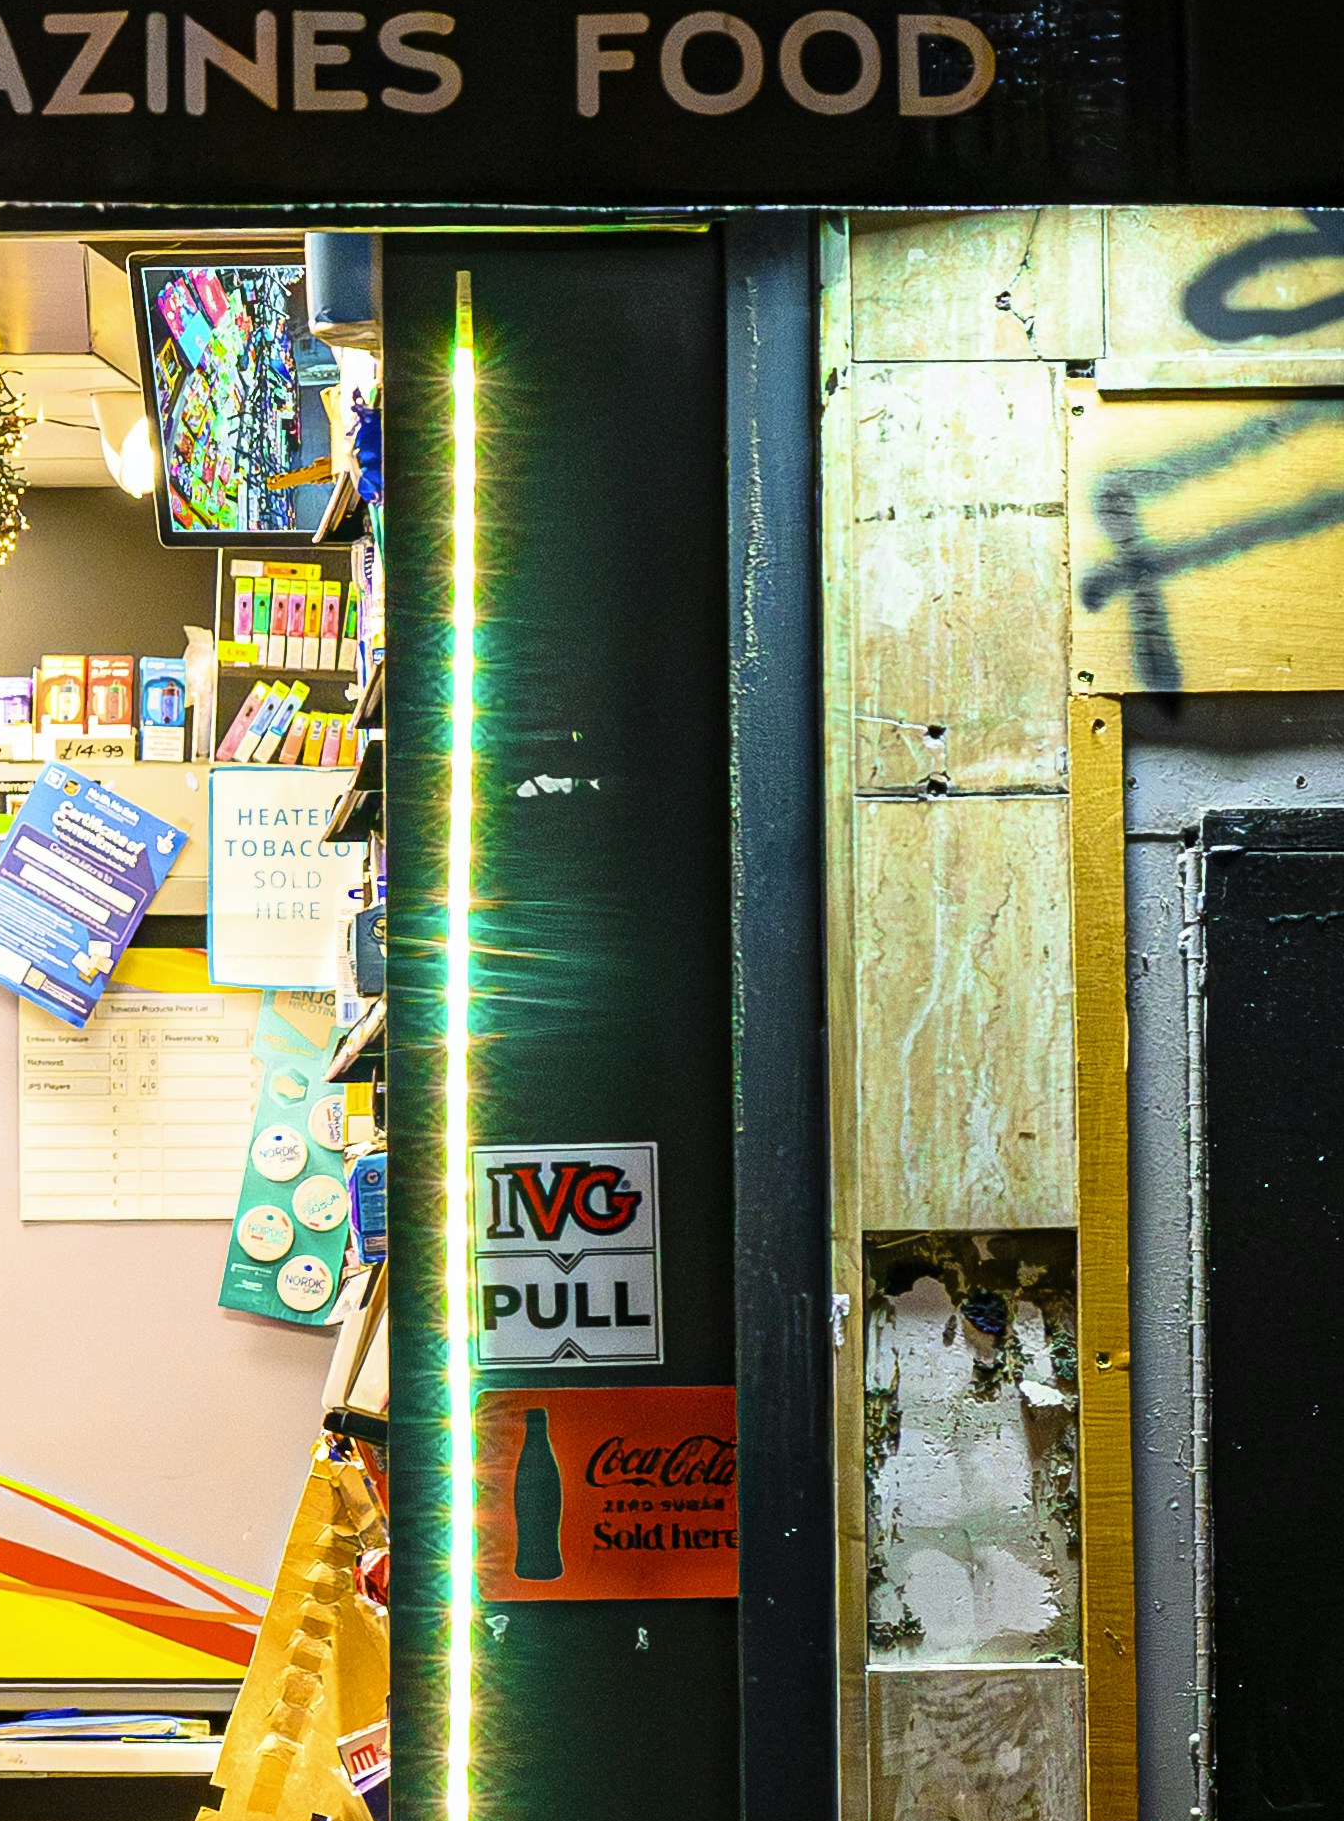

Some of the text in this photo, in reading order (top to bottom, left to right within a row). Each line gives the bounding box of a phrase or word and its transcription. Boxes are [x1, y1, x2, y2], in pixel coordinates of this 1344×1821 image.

[574, 8, 999, 119] FOOD
[224, 838, 351, 858] TOBACCO
[254, 869, 322, 890] SOLD
[255, 900, 322, 921] HERE
[485, 1160, 643, 1241] IVG
[284, 1274, 328, 1290] NORDIC
[482, 1280, 652, 1331] PULL
[593, 1522, 740, 1552] Sold here
